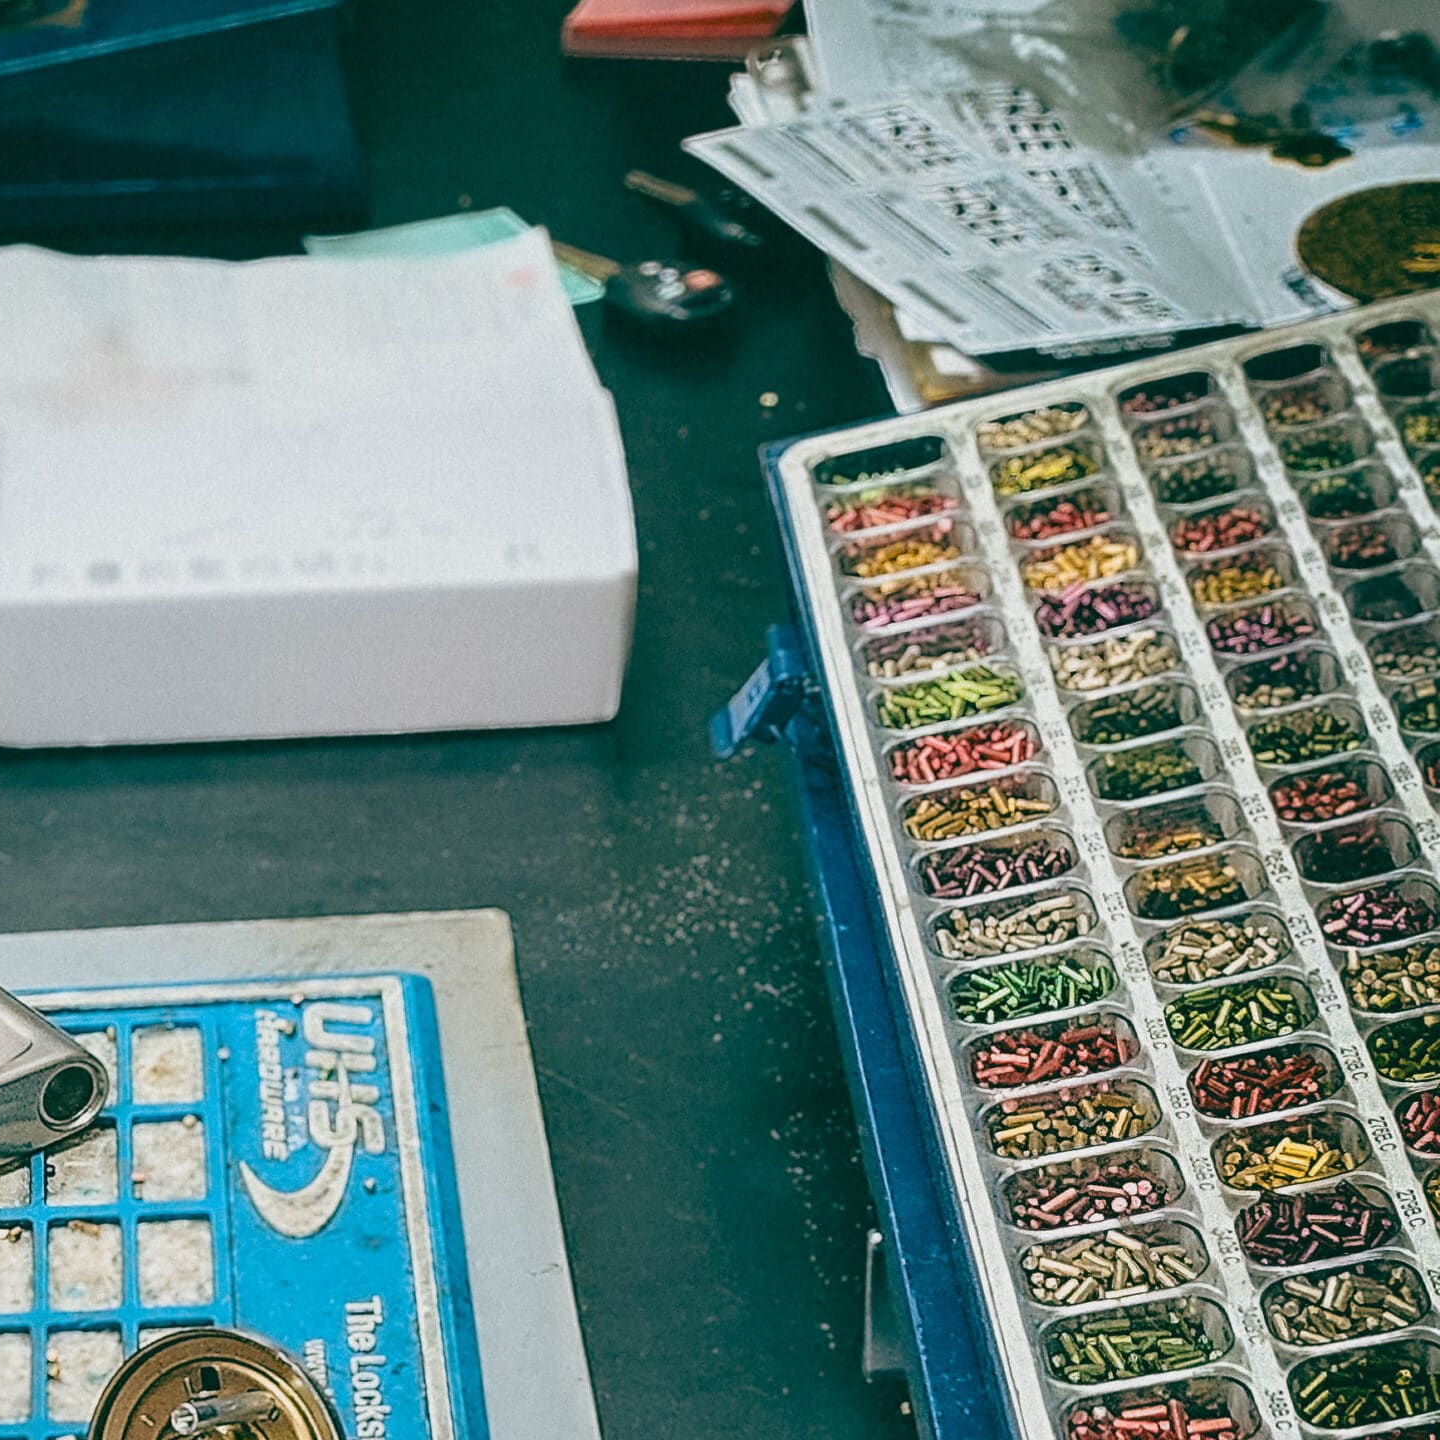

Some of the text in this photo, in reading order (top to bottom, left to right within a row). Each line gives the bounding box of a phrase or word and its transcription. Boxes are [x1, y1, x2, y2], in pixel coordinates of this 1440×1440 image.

[255, 1009, 290, 1162] HARDWARE
[302, 1002, 385, 1154] UHS
[345, 1295, 383, 1353] The
